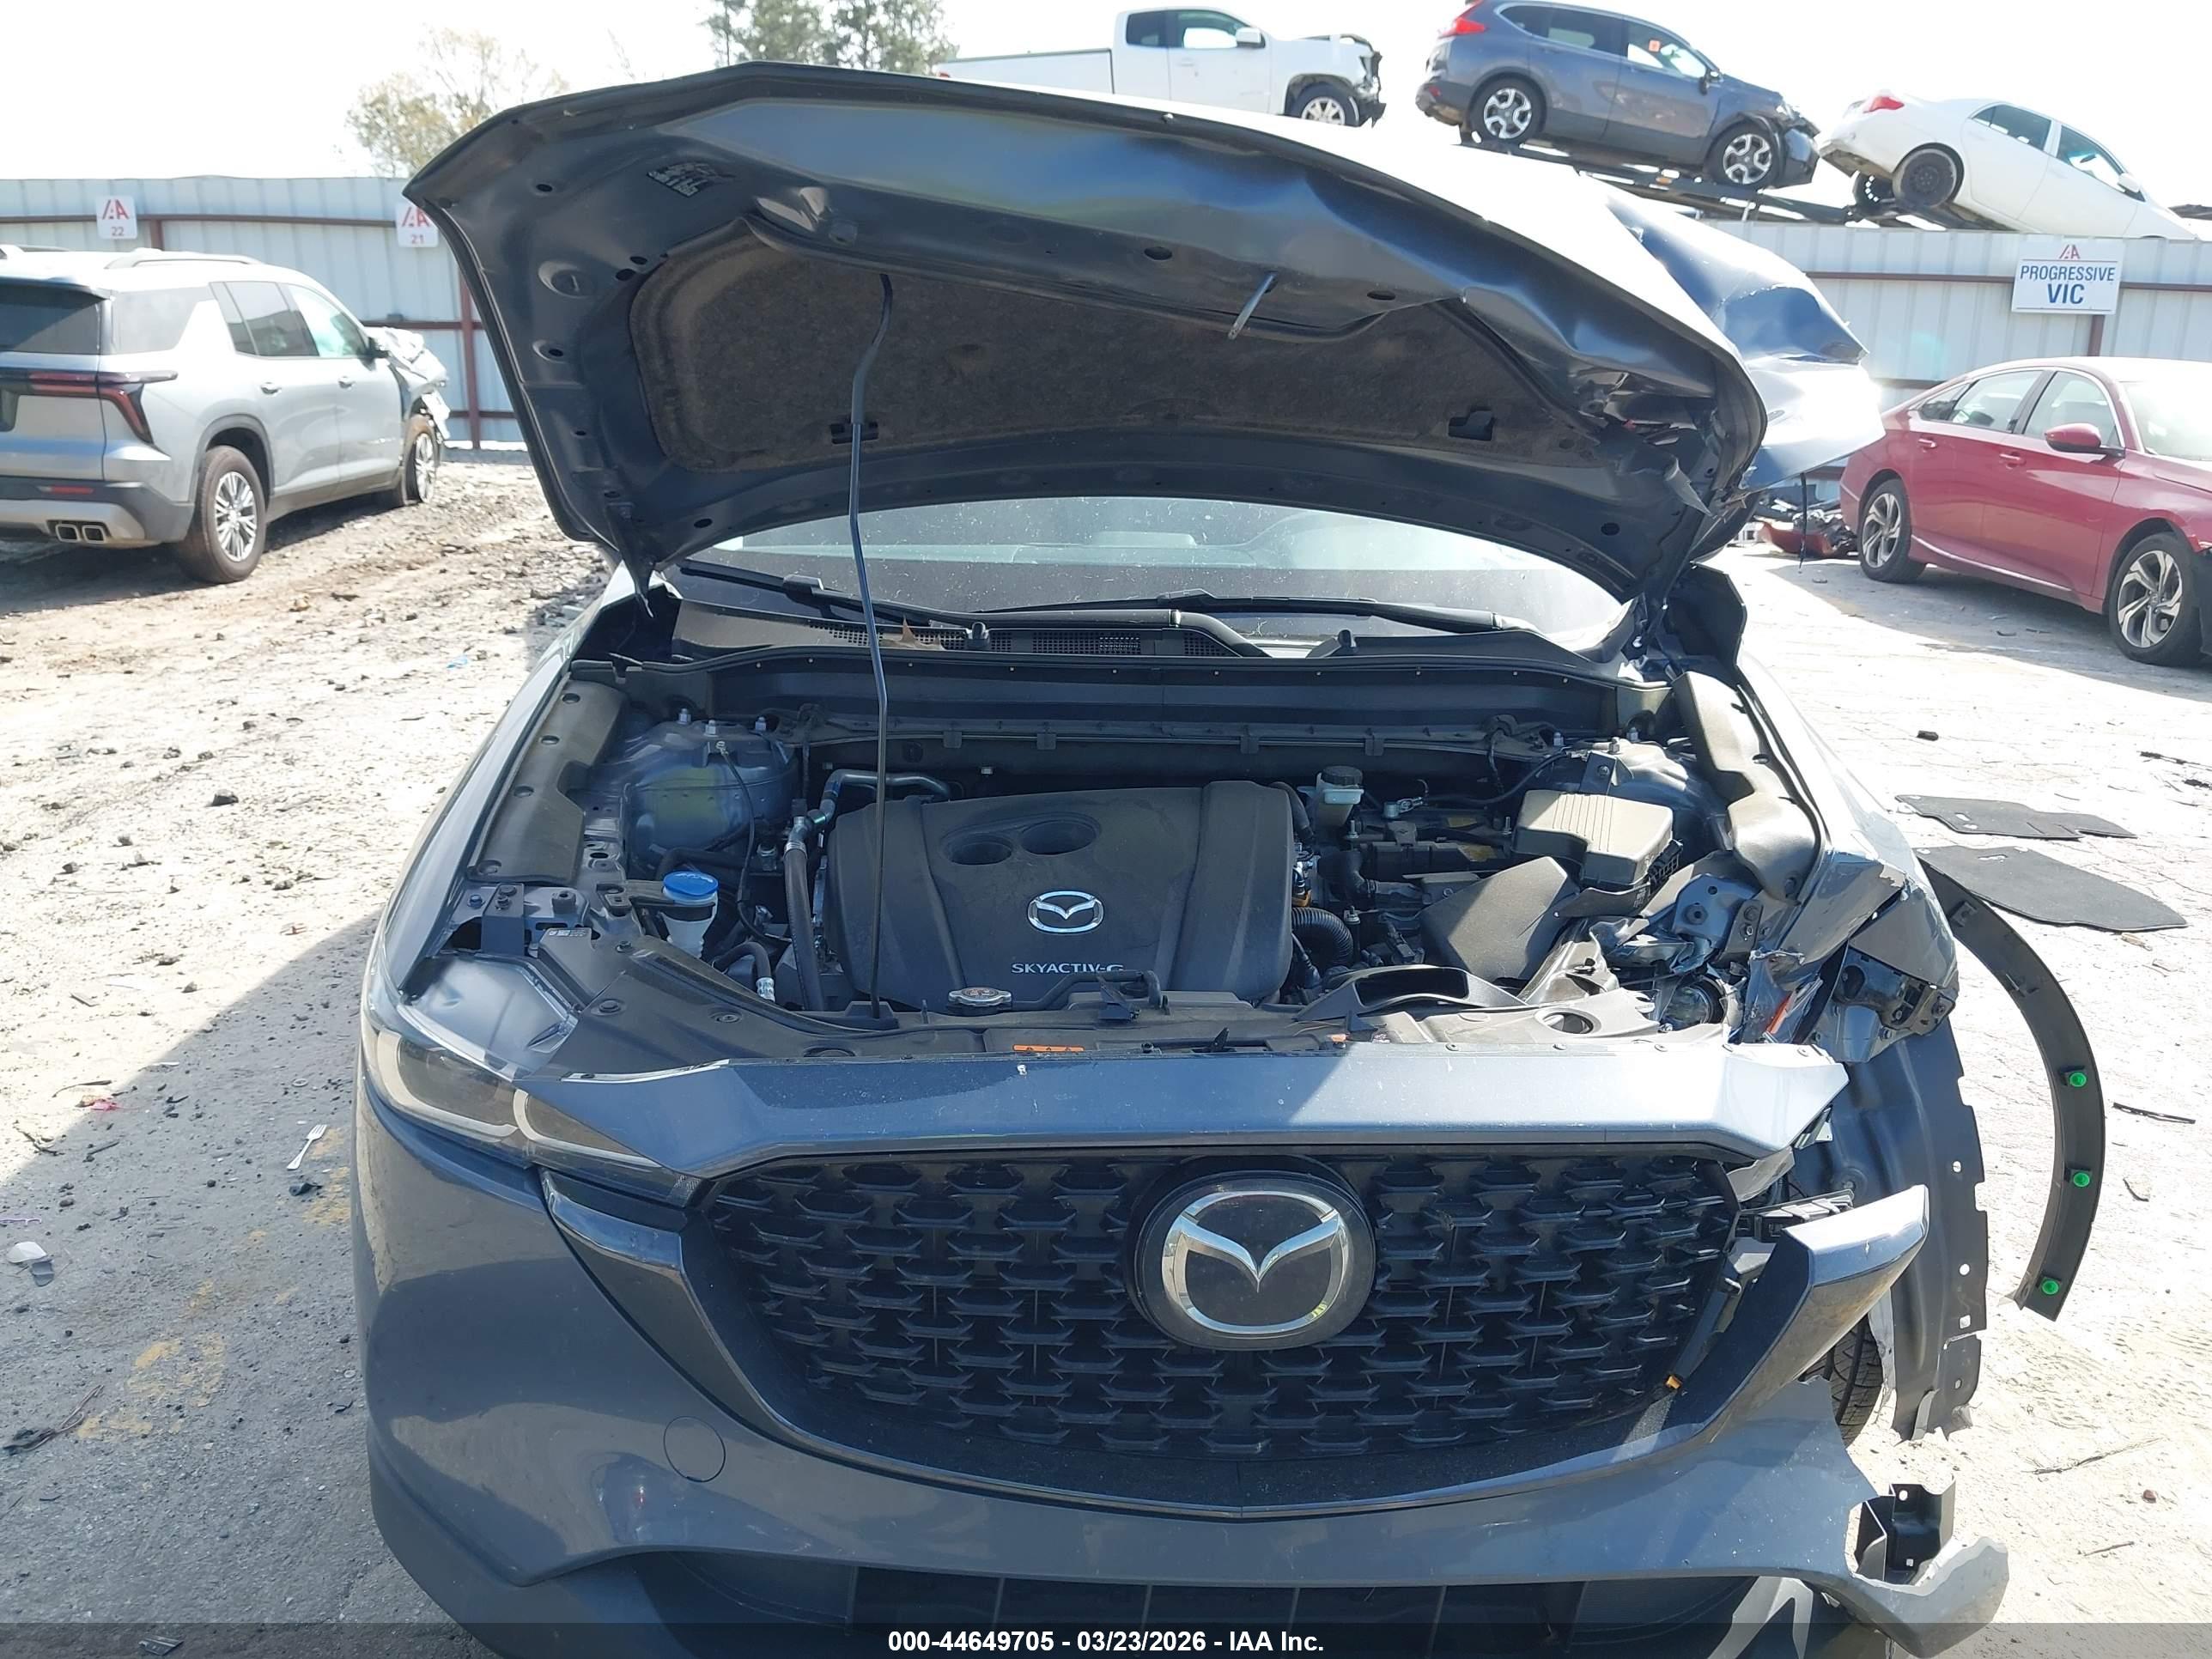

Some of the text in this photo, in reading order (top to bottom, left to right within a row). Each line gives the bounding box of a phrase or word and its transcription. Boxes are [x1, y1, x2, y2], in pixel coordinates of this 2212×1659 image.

[111, 227, 125, 237] 22
[2020, 265, 2116, 281] PROGRESSIVE
[2047, 283, 2085, 304] VIC
